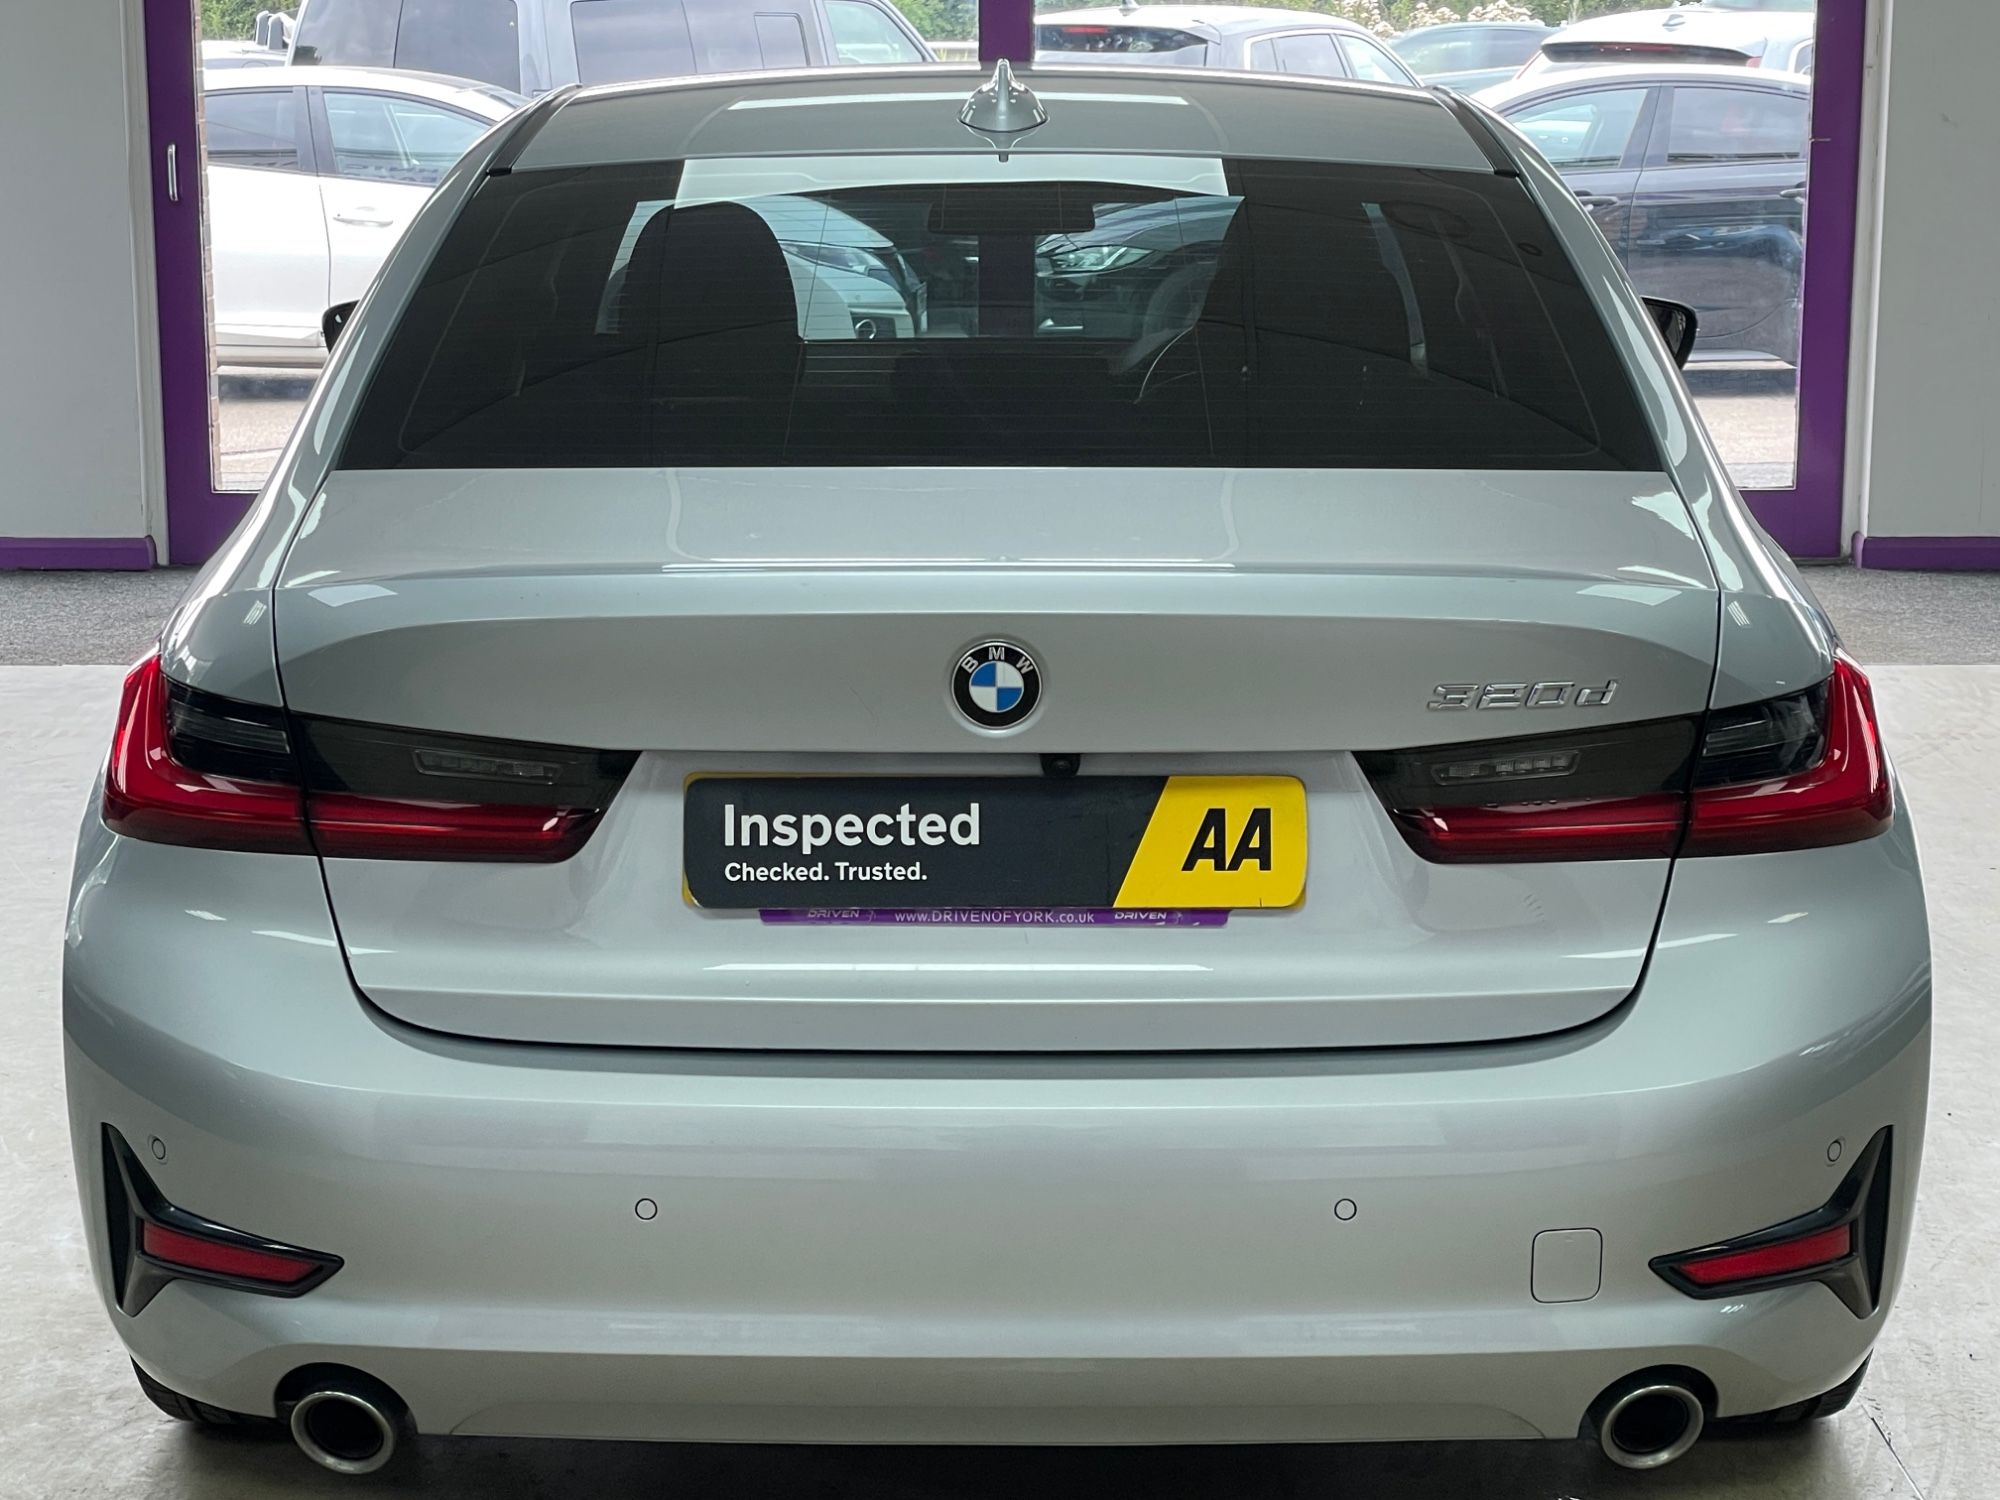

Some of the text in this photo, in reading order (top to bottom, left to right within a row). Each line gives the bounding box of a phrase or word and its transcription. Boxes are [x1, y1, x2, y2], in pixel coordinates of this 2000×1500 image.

[961, 646, 1034, 674] BMW
[1427, 680, 1618, 711] 320d
[724, 804, 980, 853] Inspected
[1182, 808, 1272, 871] AA
[724, 861, 928, 883] Checked. Trusted.
[807, 909, 1168, 924] DRIVEN www.DRIVENOFYORK.co.uk DRIVEN
